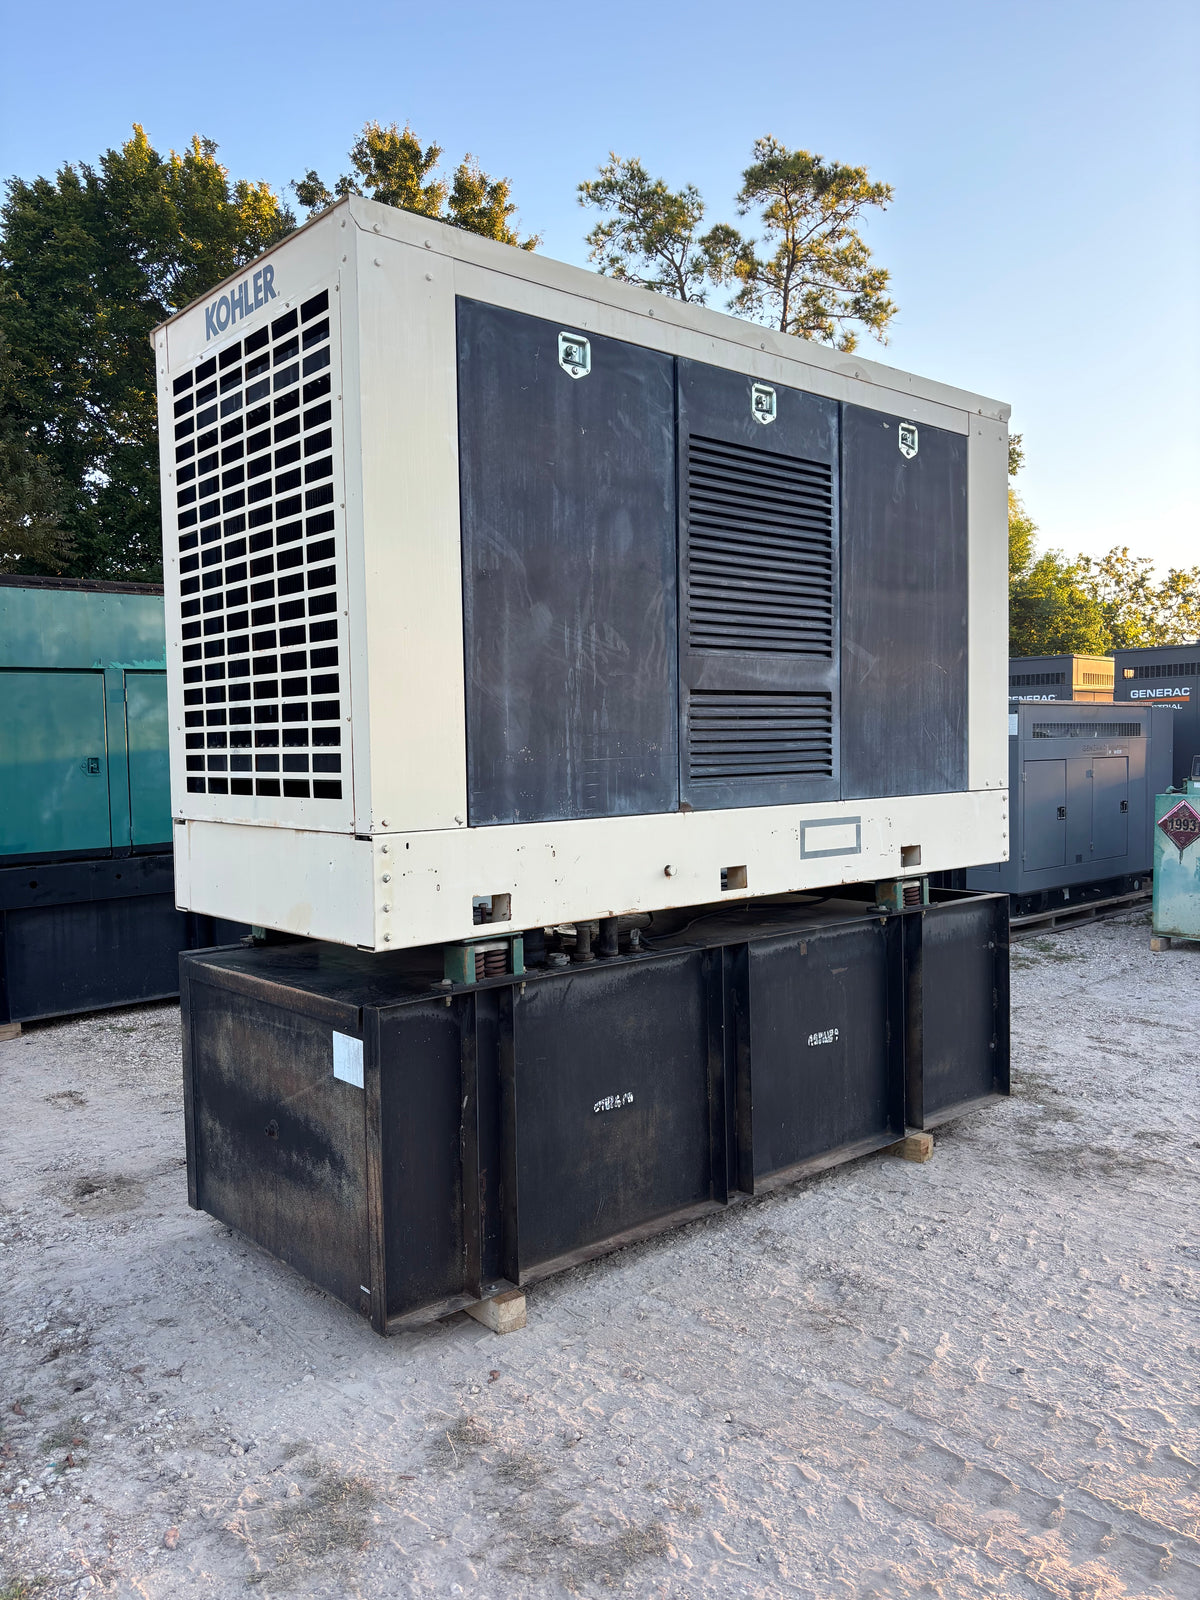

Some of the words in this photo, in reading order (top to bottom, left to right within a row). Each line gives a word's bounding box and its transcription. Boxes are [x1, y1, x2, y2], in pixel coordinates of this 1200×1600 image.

[205, 264, 277, 341] KOHLER
[1008, 694, 1057, 702] ENERAC
[1130, 687, 1190, 698] GENERAC
[1168, 818, 1197, 832] 1993
